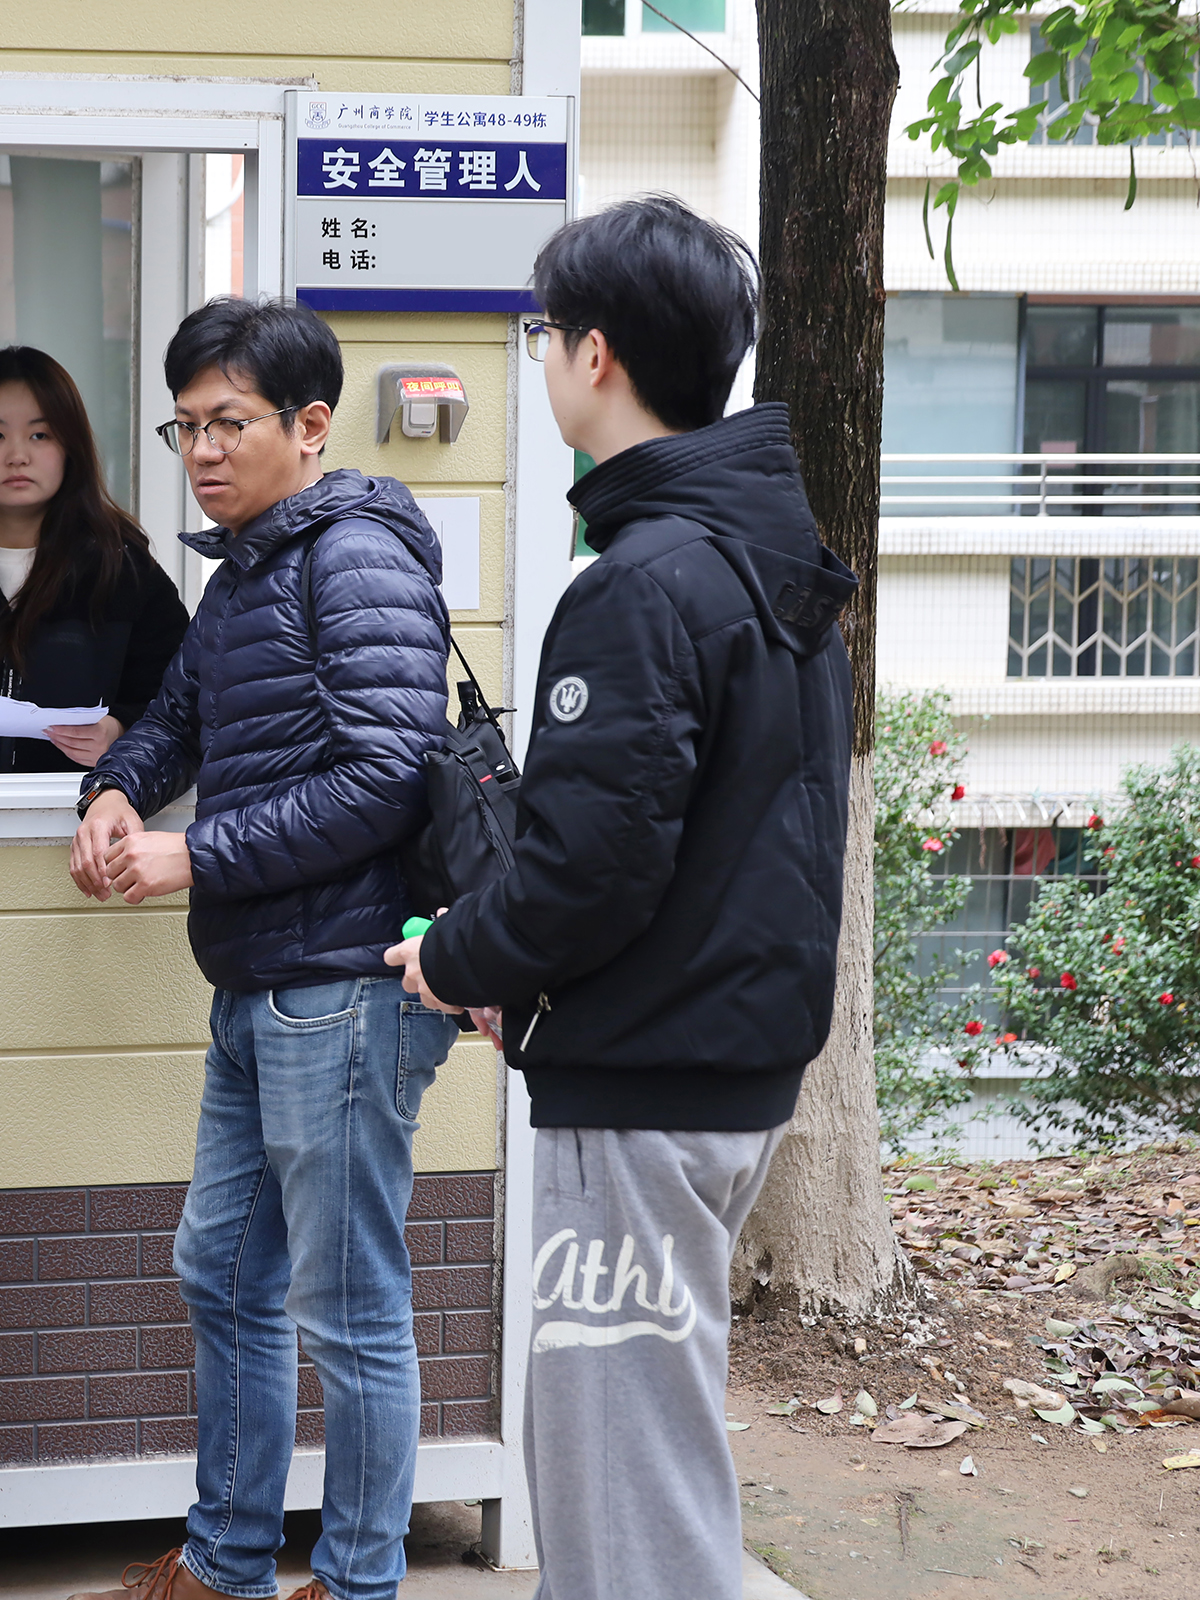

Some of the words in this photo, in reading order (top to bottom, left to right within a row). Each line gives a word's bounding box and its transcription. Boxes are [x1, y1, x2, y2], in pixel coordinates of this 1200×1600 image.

[337, 103, 413, 121] 广州商学院
[424, 110, 548, 129] 学生公寓48-49栋
[321, 146, 542, 192] 安全管理人
[405, 381, 461, 392] 夜间呼叫
